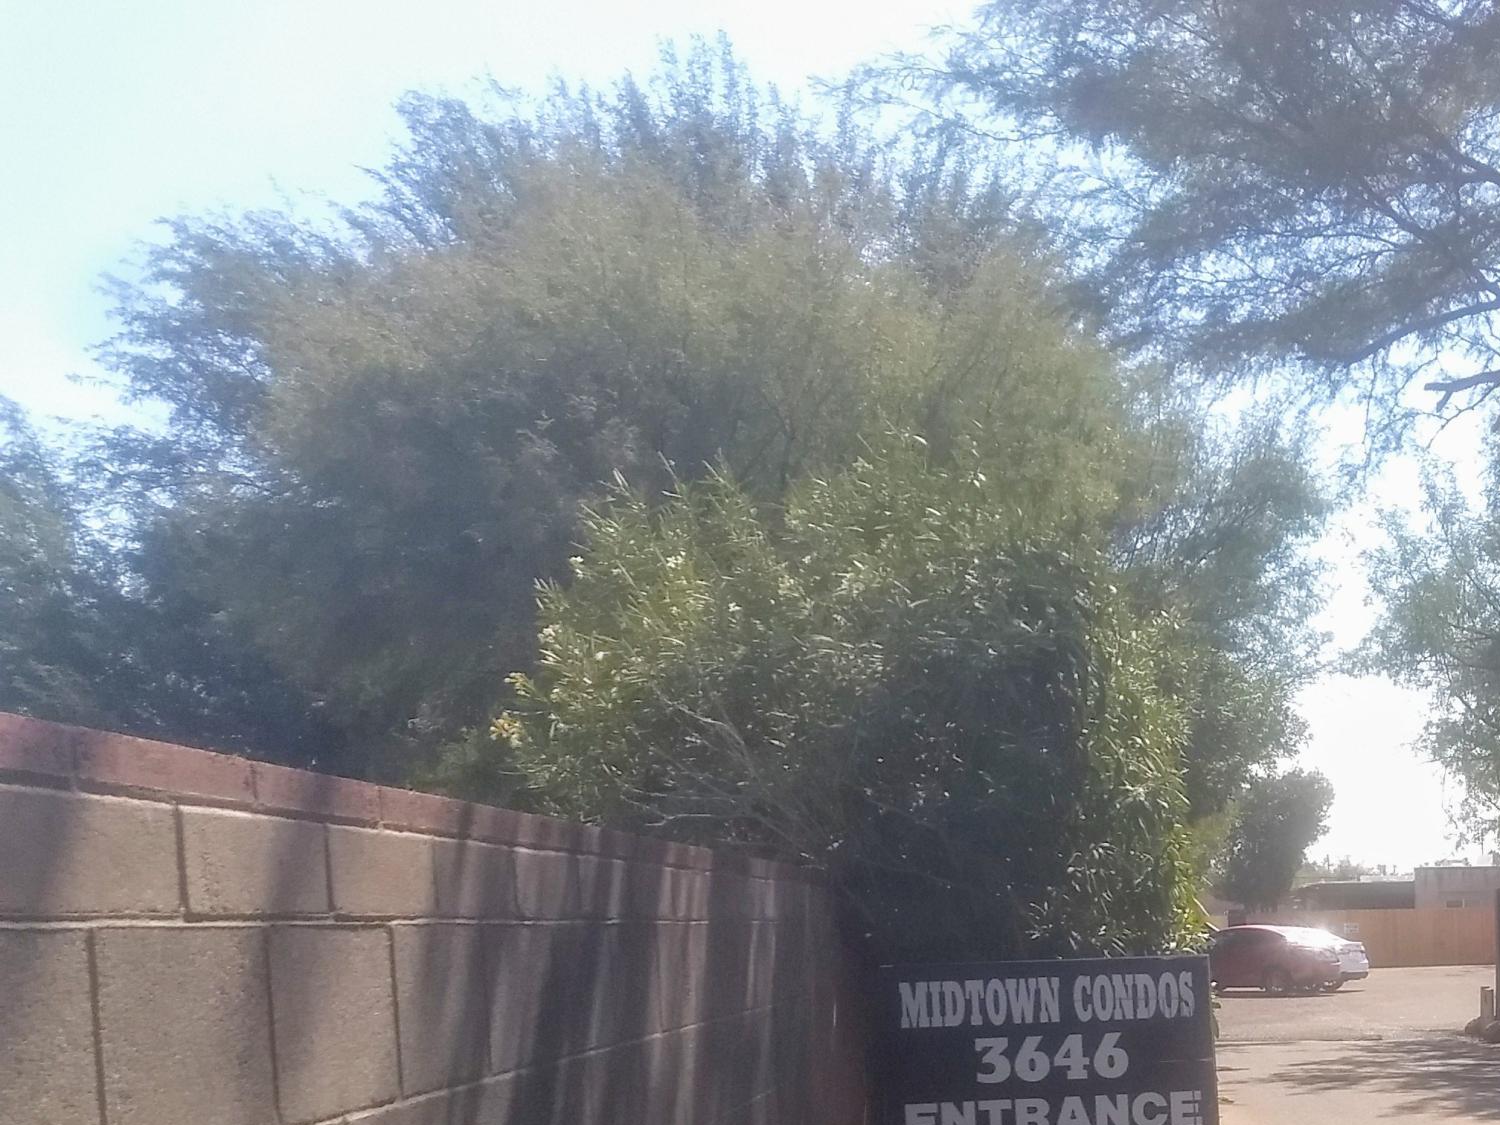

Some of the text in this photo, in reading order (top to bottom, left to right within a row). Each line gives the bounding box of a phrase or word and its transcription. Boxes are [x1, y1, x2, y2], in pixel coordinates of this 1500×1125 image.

[899, 971, 1196, 1028] MIDTOWN CONDOS
[974, 1032, 1129, 1084] 3646
